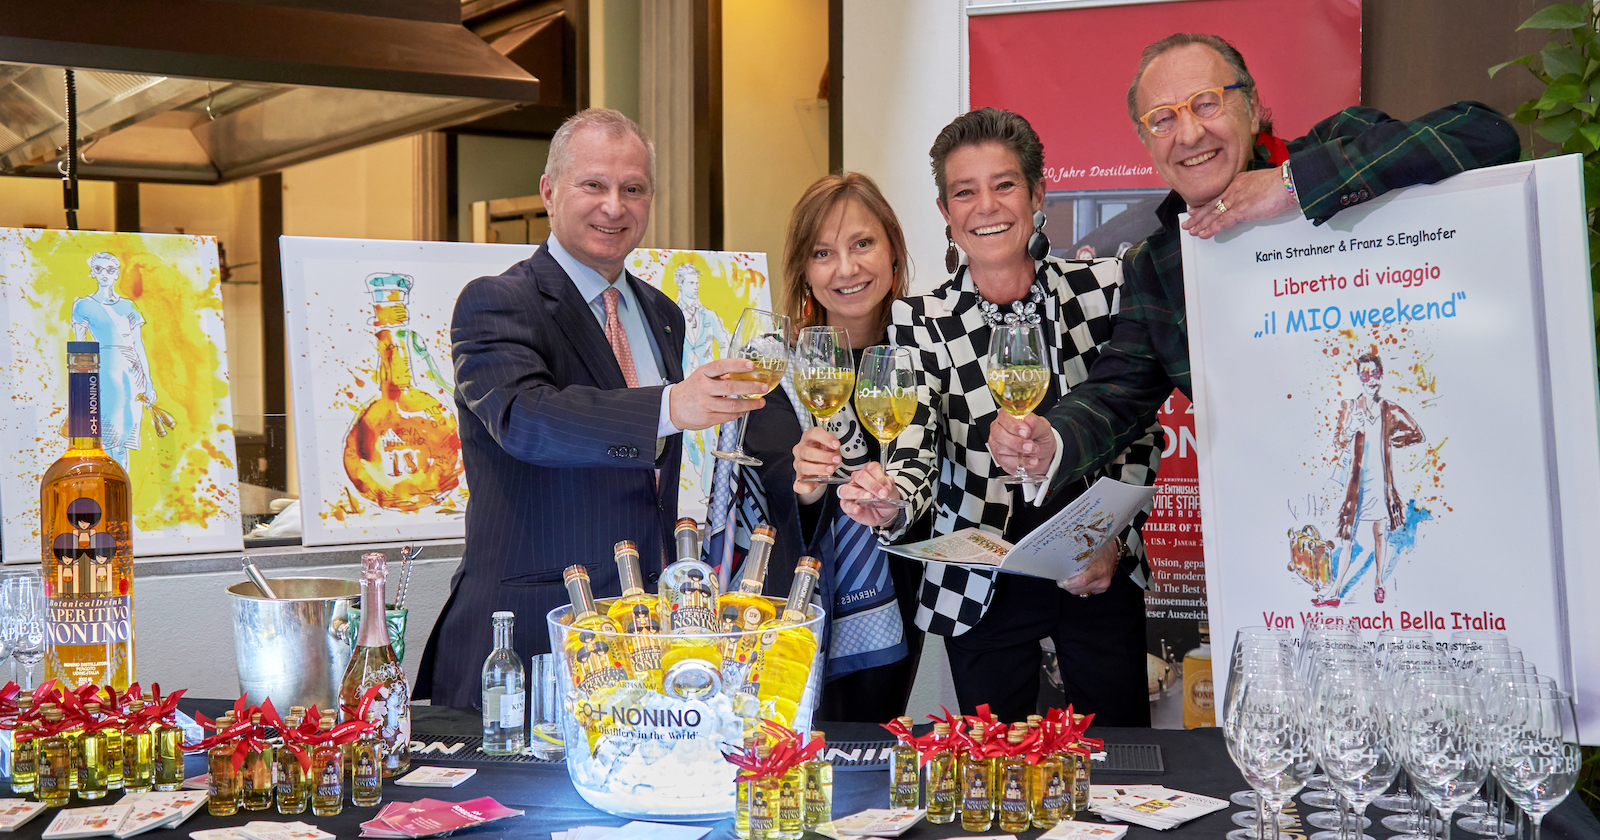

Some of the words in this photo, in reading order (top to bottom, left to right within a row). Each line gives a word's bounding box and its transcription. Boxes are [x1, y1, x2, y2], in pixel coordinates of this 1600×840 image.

[1053, 166, 1085, 182] Jahre
[1089, 164, 1152, 177] Destillation
[1256, 249, 1283, 263] Karin
[1286, 244, 1335, 259] Strahner
[1339, 241, 1347, 252] &
[1350, 238, 1383, 251] Franz
[1386, 228, 1456, 247] S.Englhofer
[1274, 274, 1347, 297] Libretto
[1354, 268, 1370, 287] di
[1376, 262, 1441, 288] viaggio
[1286, 306, 1341, 334] MIO
[1179, 523, 1192, 532] OF
[1152, 558, 1182, 568] Vision,
[1158, 570, 1171, 579] für
[1163, 583, 1180, 592] The
[1182, 584, 1200, 594] Best
[1263, 611, 1294, 630] Von
[1300, 612, 1344, 630] Wien
[1349, 611, 1393, 630] nach
[1401, 611, 1445, 630] Bella
[1450, 611, 1506, 630] Italia
[46, 620, 130, 644] NONINO
[612, 706, 702, 727] NONINO
[600, 725, 635, 738] Distillery
[638, 731, 647, 739] in
[650, 731, 665, 740] the
